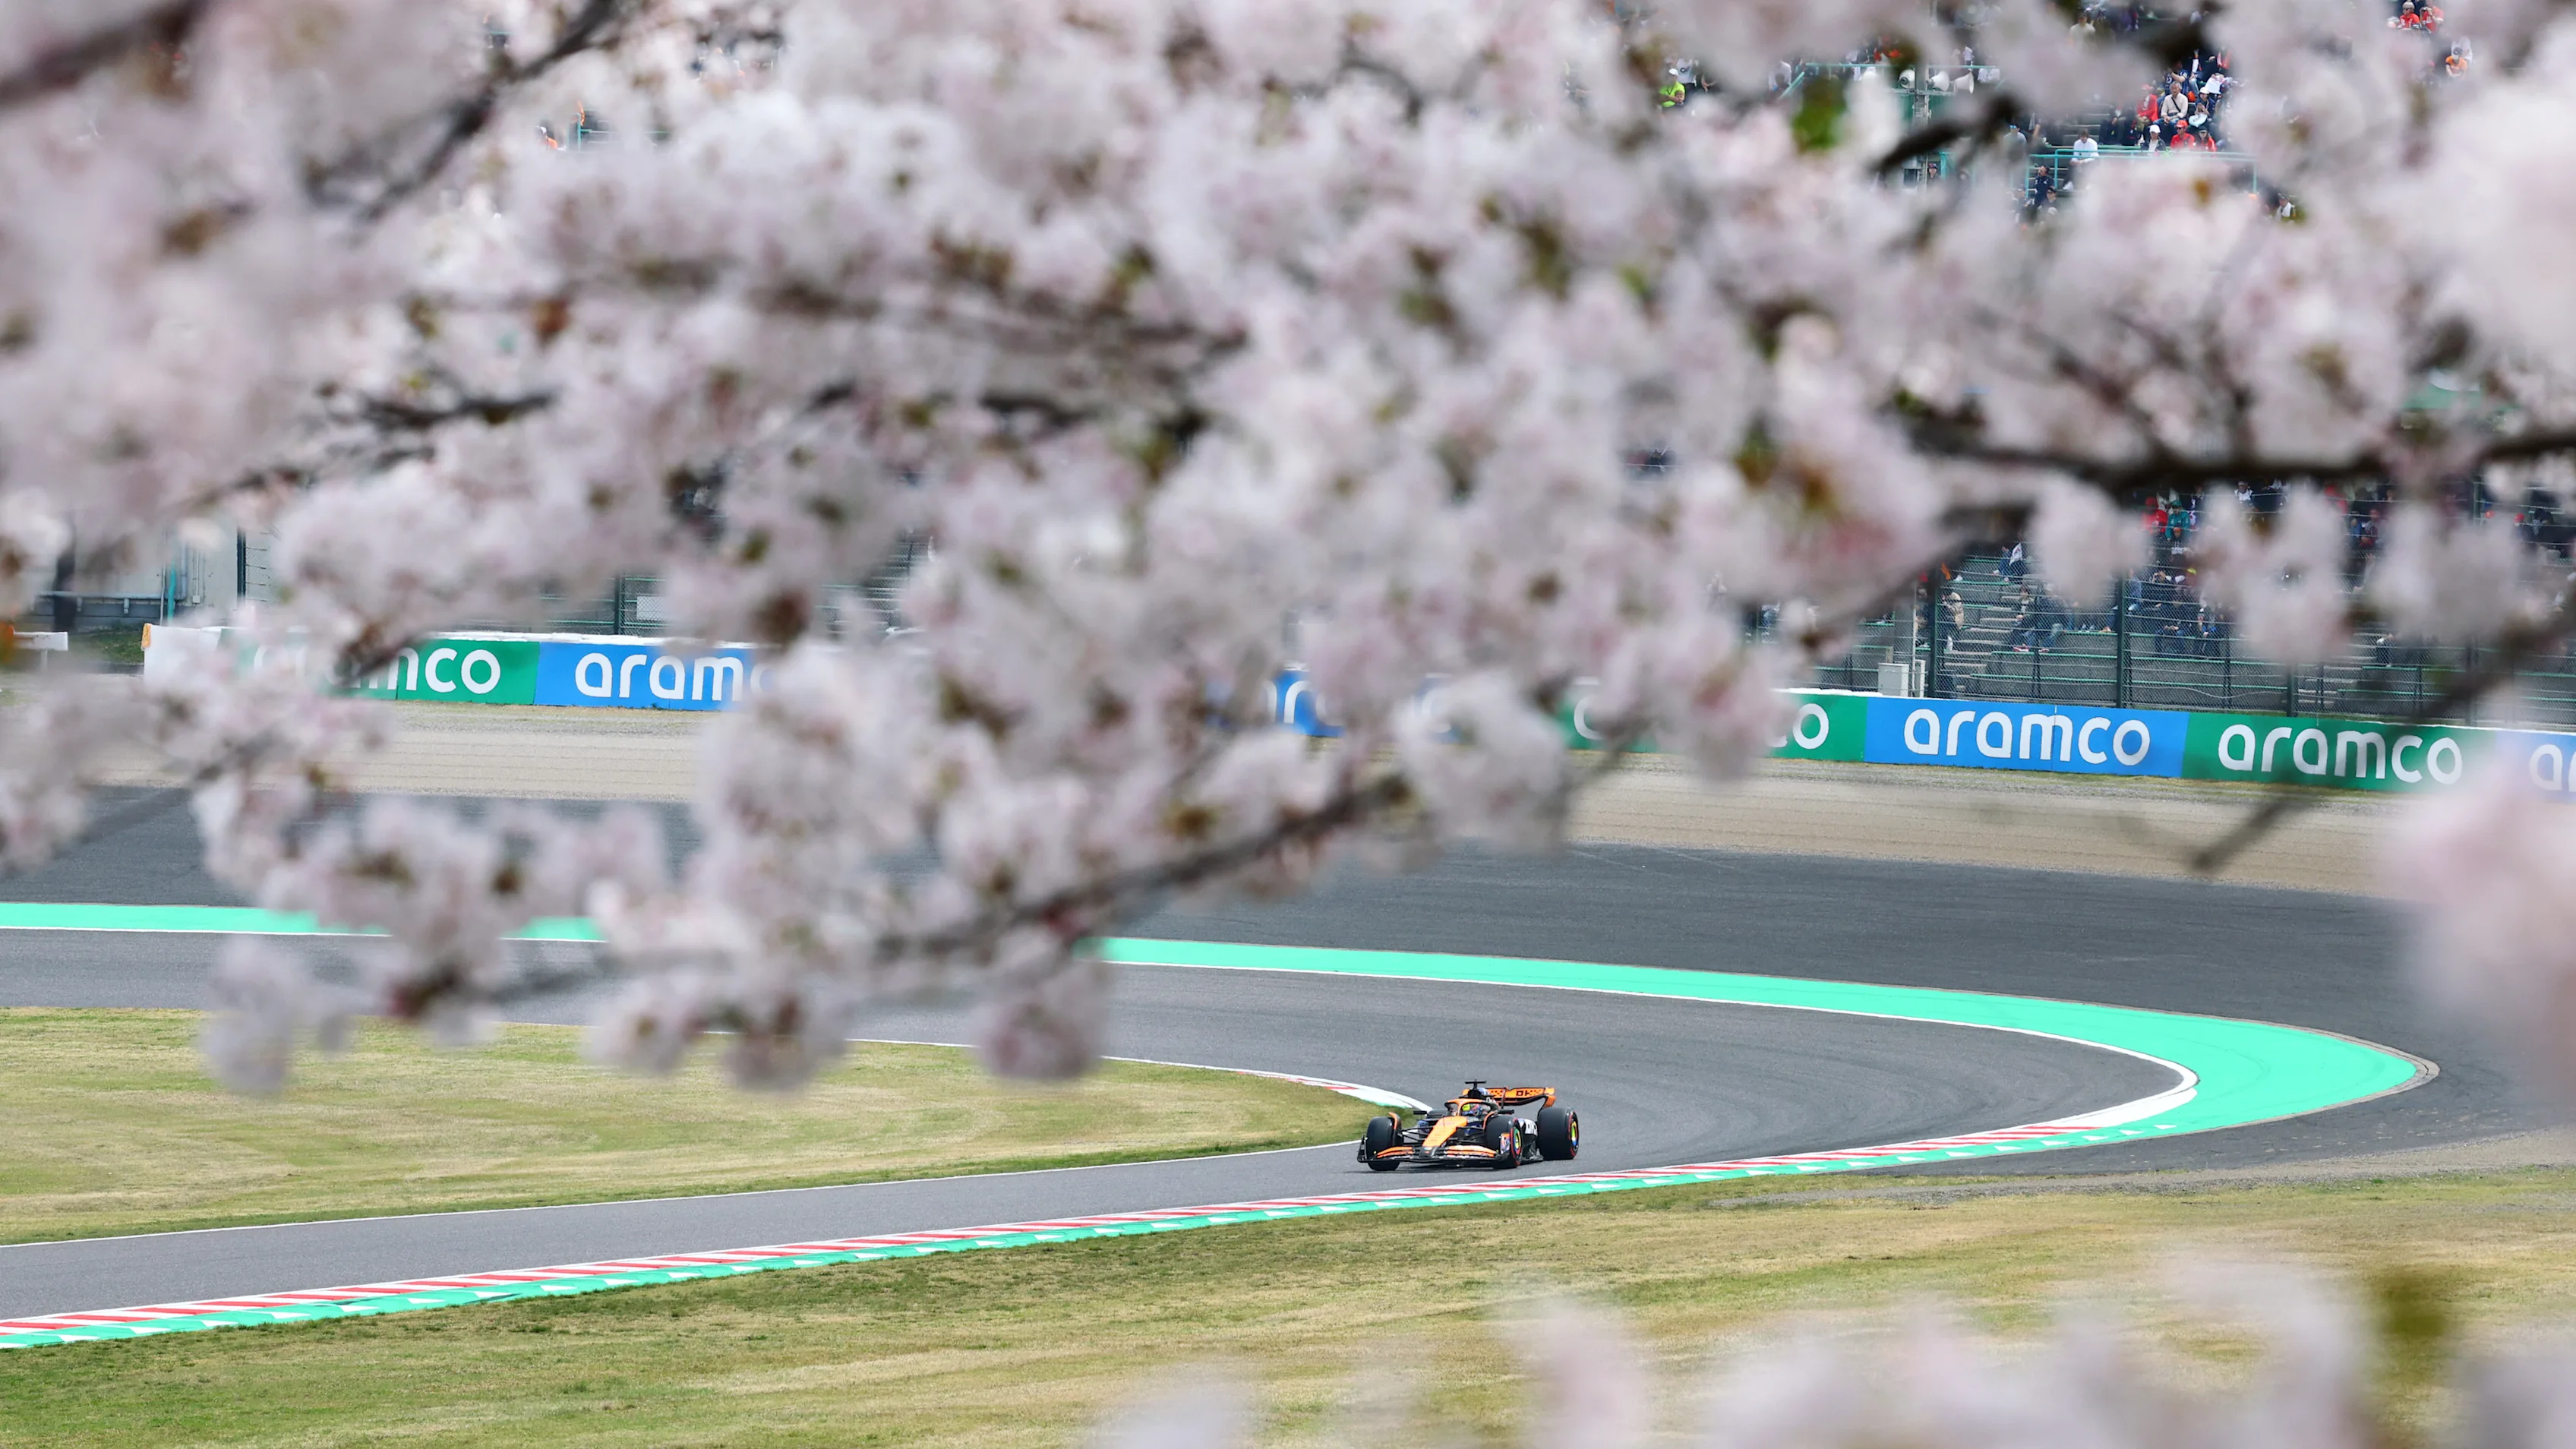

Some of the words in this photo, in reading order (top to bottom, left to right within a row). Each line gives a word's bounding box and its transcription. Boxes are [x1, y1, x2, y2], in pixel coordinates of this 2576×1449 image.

[575, 652, 769, 702] aram
[1903, 709, 2151, 766] aramco
[2218, 724, 2463, 785] aramco
